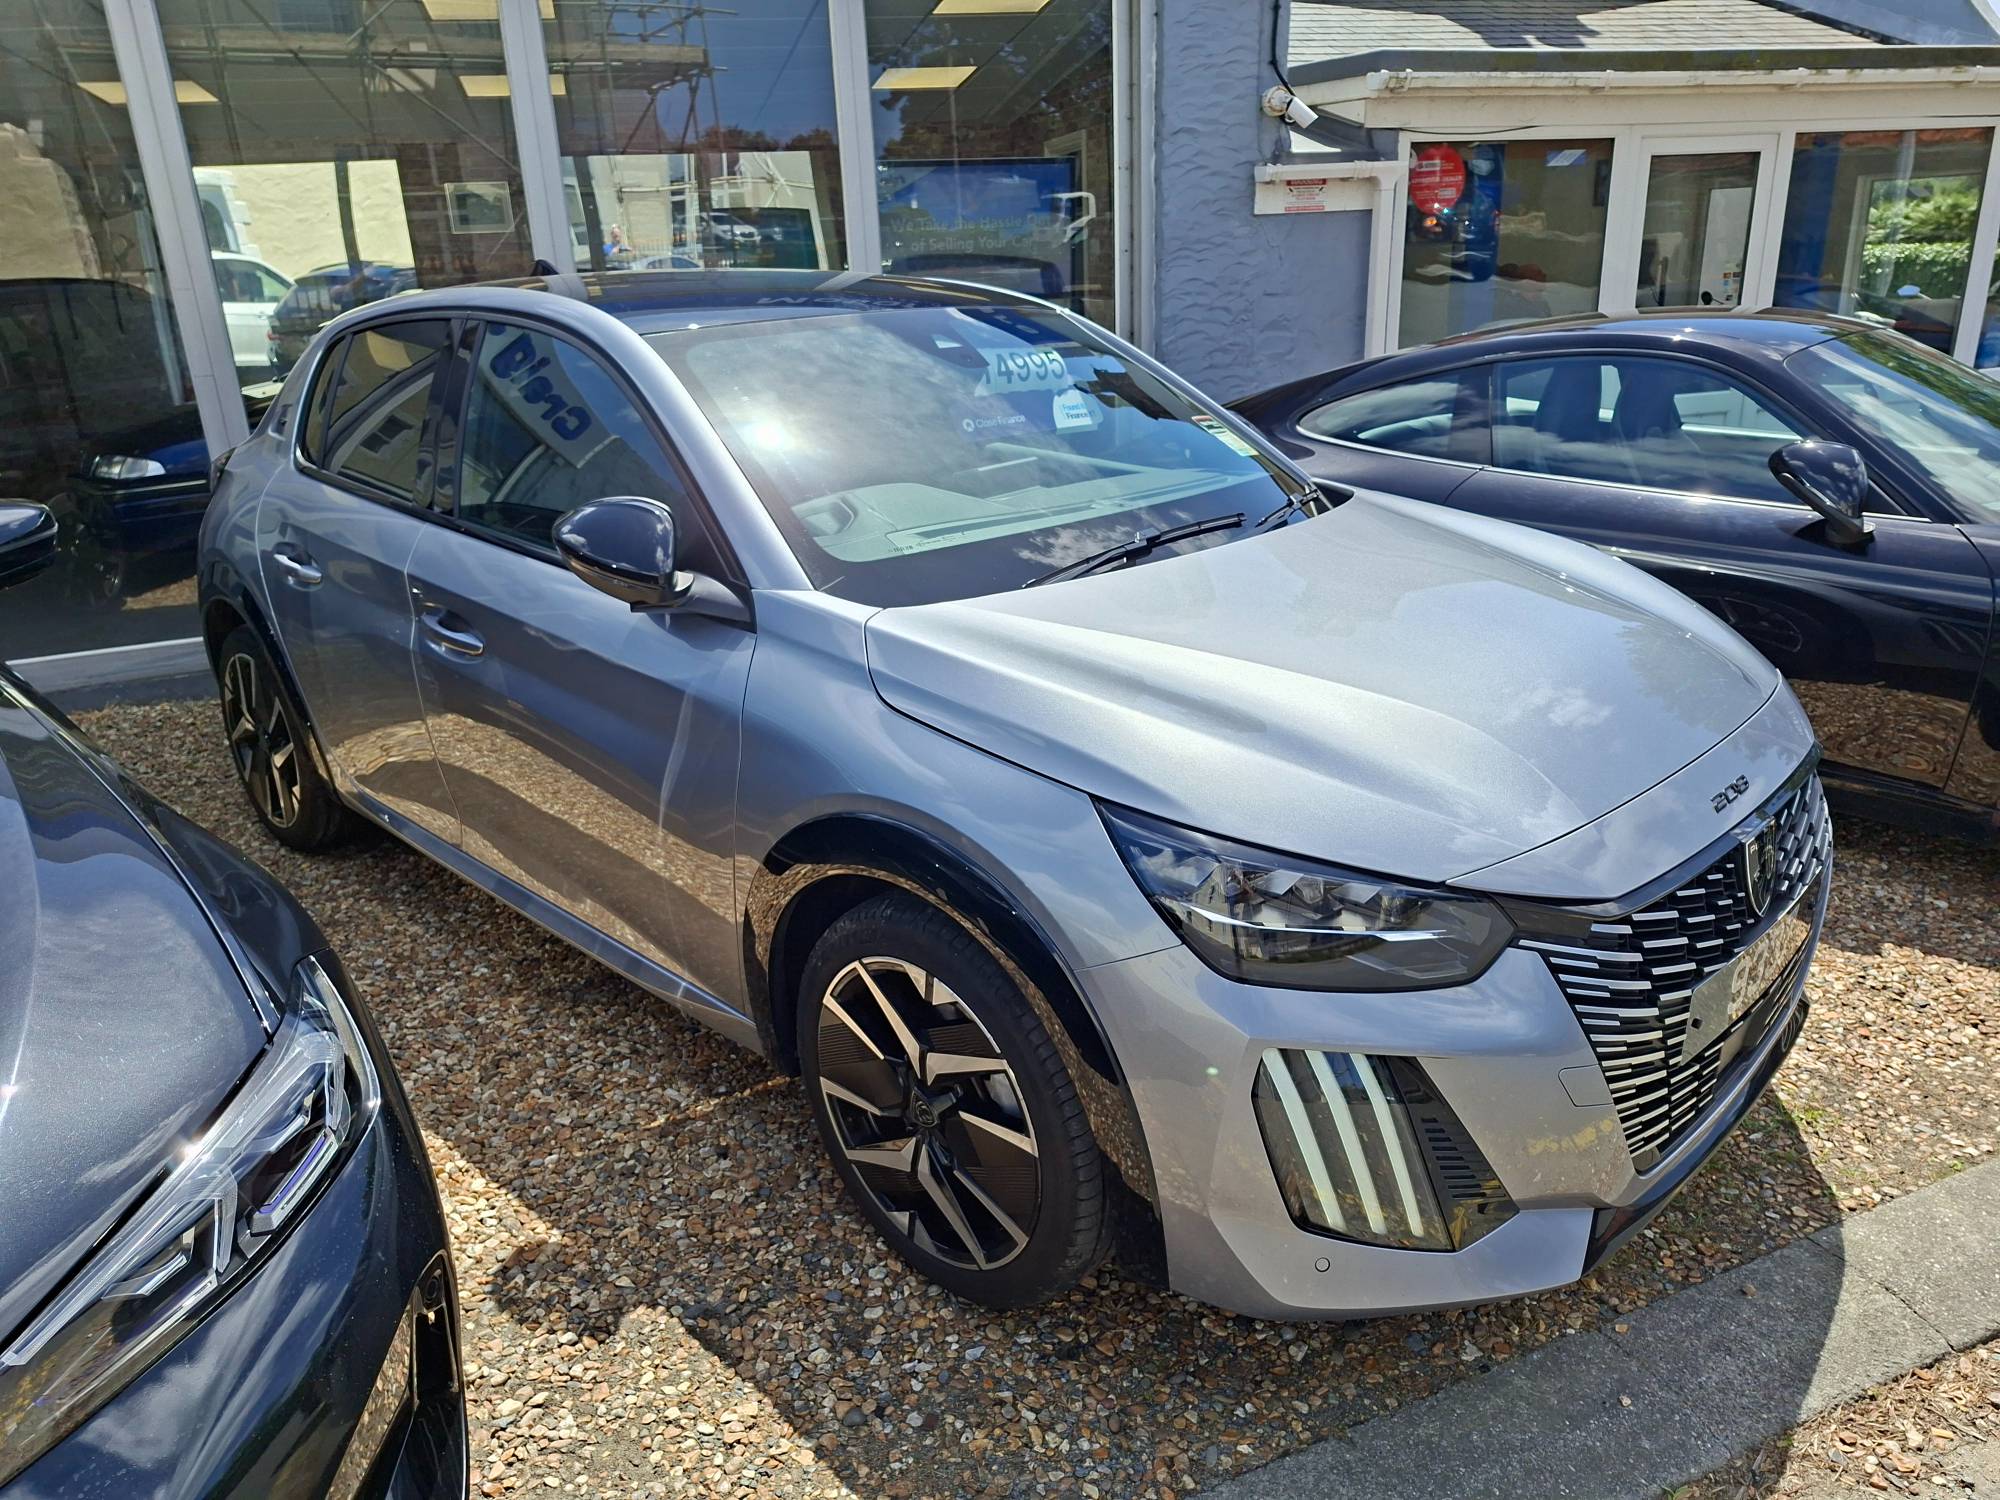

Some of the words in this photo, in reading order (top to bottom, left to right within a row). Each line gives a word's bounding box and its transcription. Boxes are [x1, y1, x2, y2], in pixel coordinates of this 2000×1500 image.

[911, 237, 928, 252] of
[928, 236, 975, 253] Selling
[977, 235, 1007, 249] Your
[1710, 774, 1749, 813] 208
